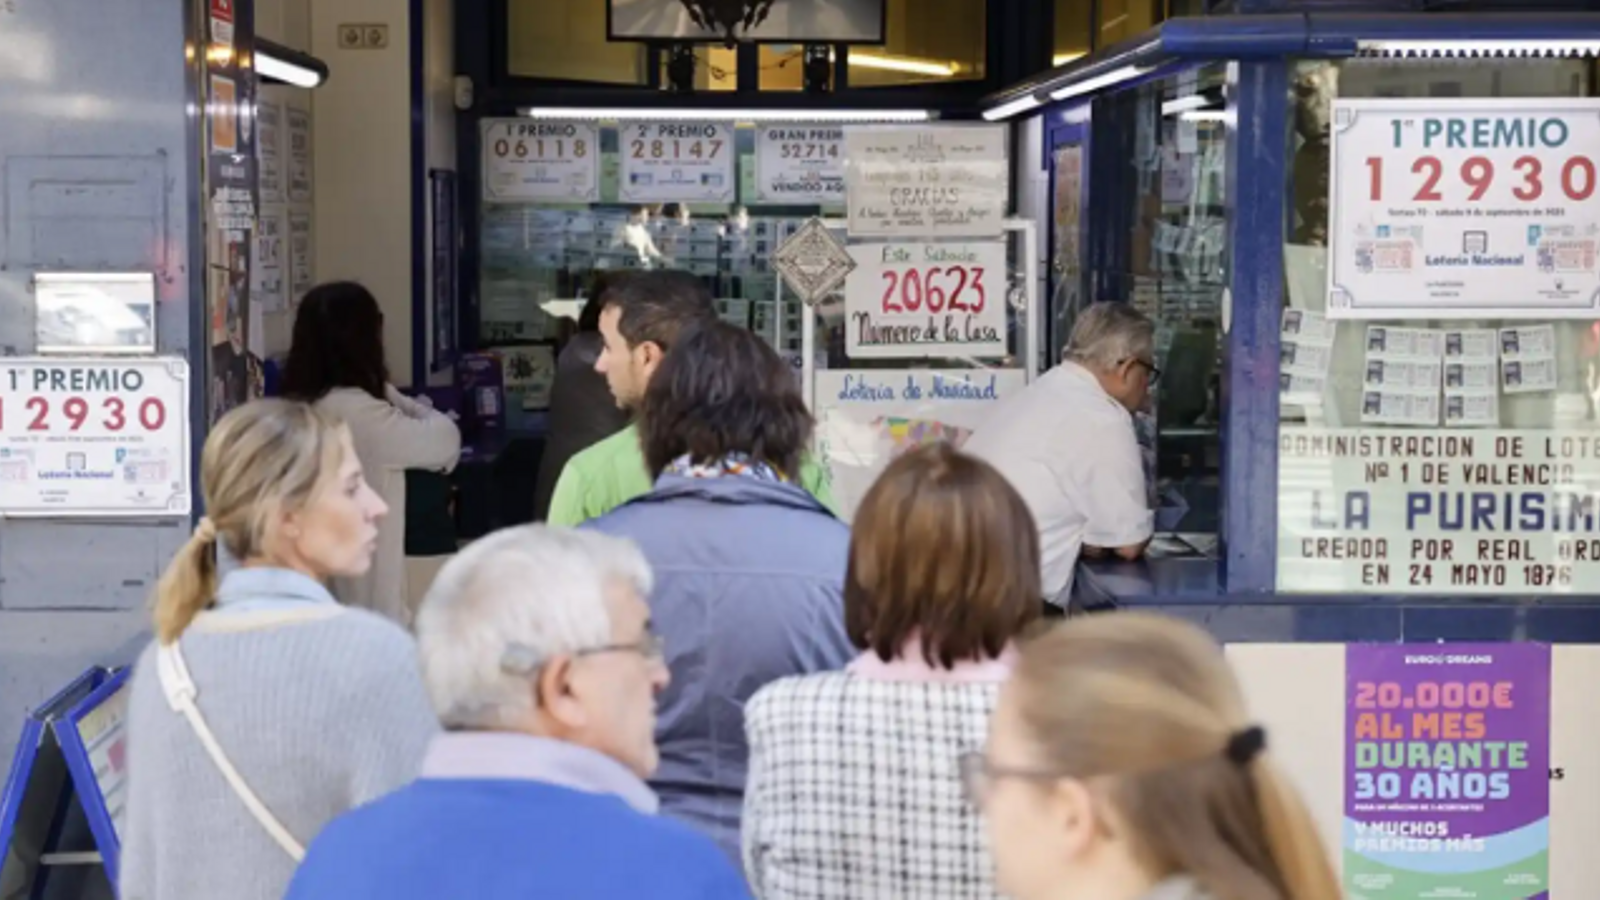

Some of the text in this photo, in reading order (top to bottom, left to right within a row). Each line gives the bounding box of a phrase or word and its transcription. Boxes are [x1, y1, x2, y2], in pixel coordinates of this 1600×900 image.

[519, 123, 577, 137] PREMIO
[658, 123, 717, 138] PREMIO
[768, 129, 806, 140] GRAN
[1422, 118, 1569, 148] PREMIO
[494, 139, 587, 158] 06118
[630, 139, 724, 158] 28147
[780, 144, 839, 158] 52714
[771, 182, 823, 193] VENDIDO
[1365, 156, 1597, 201] 12930
[882, 245, 911, 262] Este
[881, 266, 986, 314] 20623
[923, 316, 939, 340] de
[944, 315, 959, 342] la
[965, 315, 1001, 342] Casa
[32, 368, 144, 391] PREMIO
[902, 375, 922, 400] de
[928, 374, 999, 400] Navidad
[0, 396, 166, 431] 2930
[1280, 435, 1474, 457] ADMINISTRACION
[1496, 436, 1523, 457] DE
[1401, 463, 1409, 483] 1
[1422, 463, 1449, 484] DE
[1463, 463, 1574, 484] VALENCIA
[1311, 490, 1600, 531] LA PURISIM
[1302, 538, 1389, 559] CREADA
[1411, 539, 1454, 560] POR
[1478, 540, 1536, 560] REAL
[1362, 564, 1573, 586] EN 24 MAYO 1876
[1355, 682, 1514, 709] 20.000€
[1355, 713, 1486, 739] AL MES
[1355, 741, 1529, 768] DURANTE
[1354, 764, 1510, 799] 30 AÑOS
[1354, 821, 1449, 836] Y MUCHOS
[1354, 833, 1485, 853] PREMIOS MÁS
